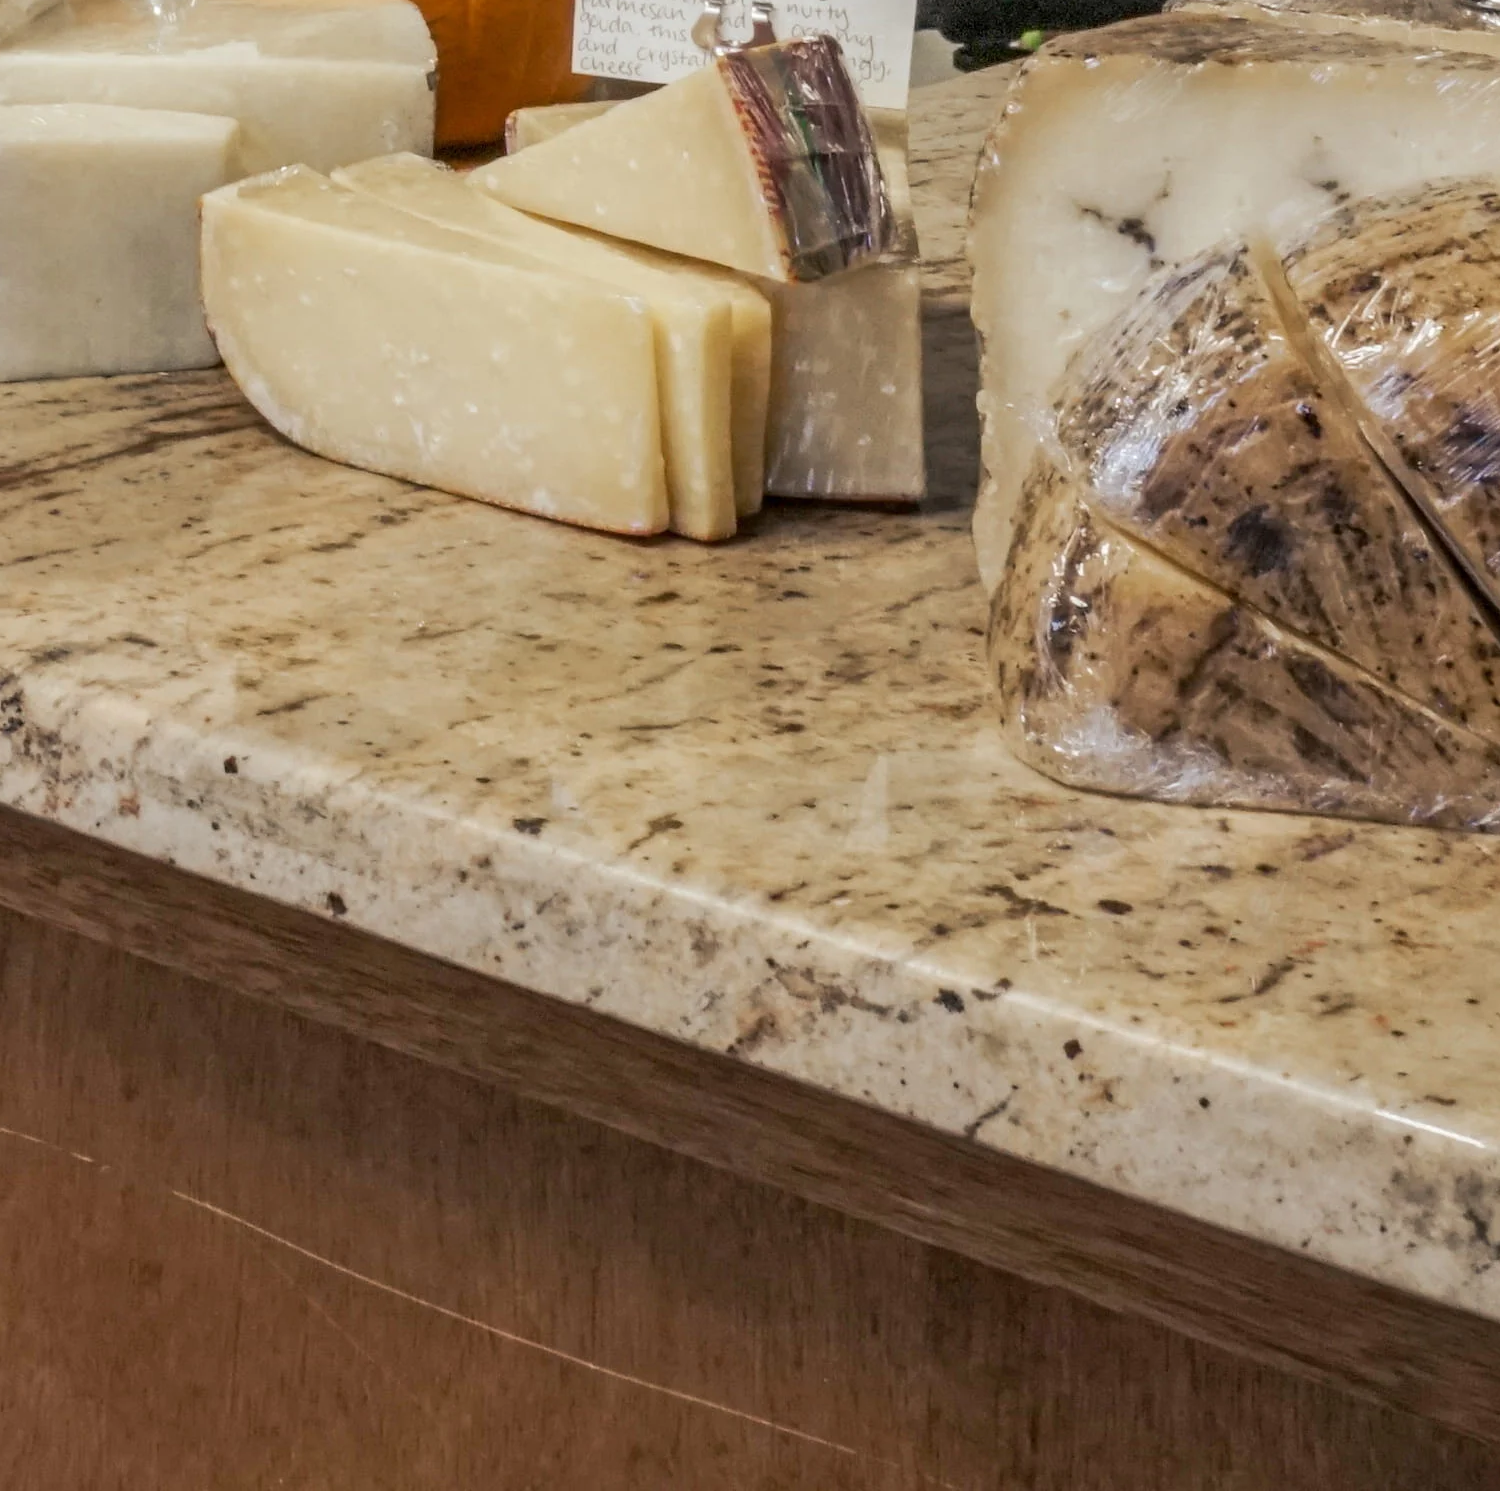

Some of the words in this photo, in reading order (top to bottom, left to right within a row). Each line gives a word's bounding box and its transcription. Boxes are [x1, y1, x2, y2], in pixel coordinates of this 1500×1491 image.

[787, 2, 849, 31] nutty
[649, 22, 688, 42] this
[577, 38, 618, 56] and
[580, 57, 644, 76] cheese
